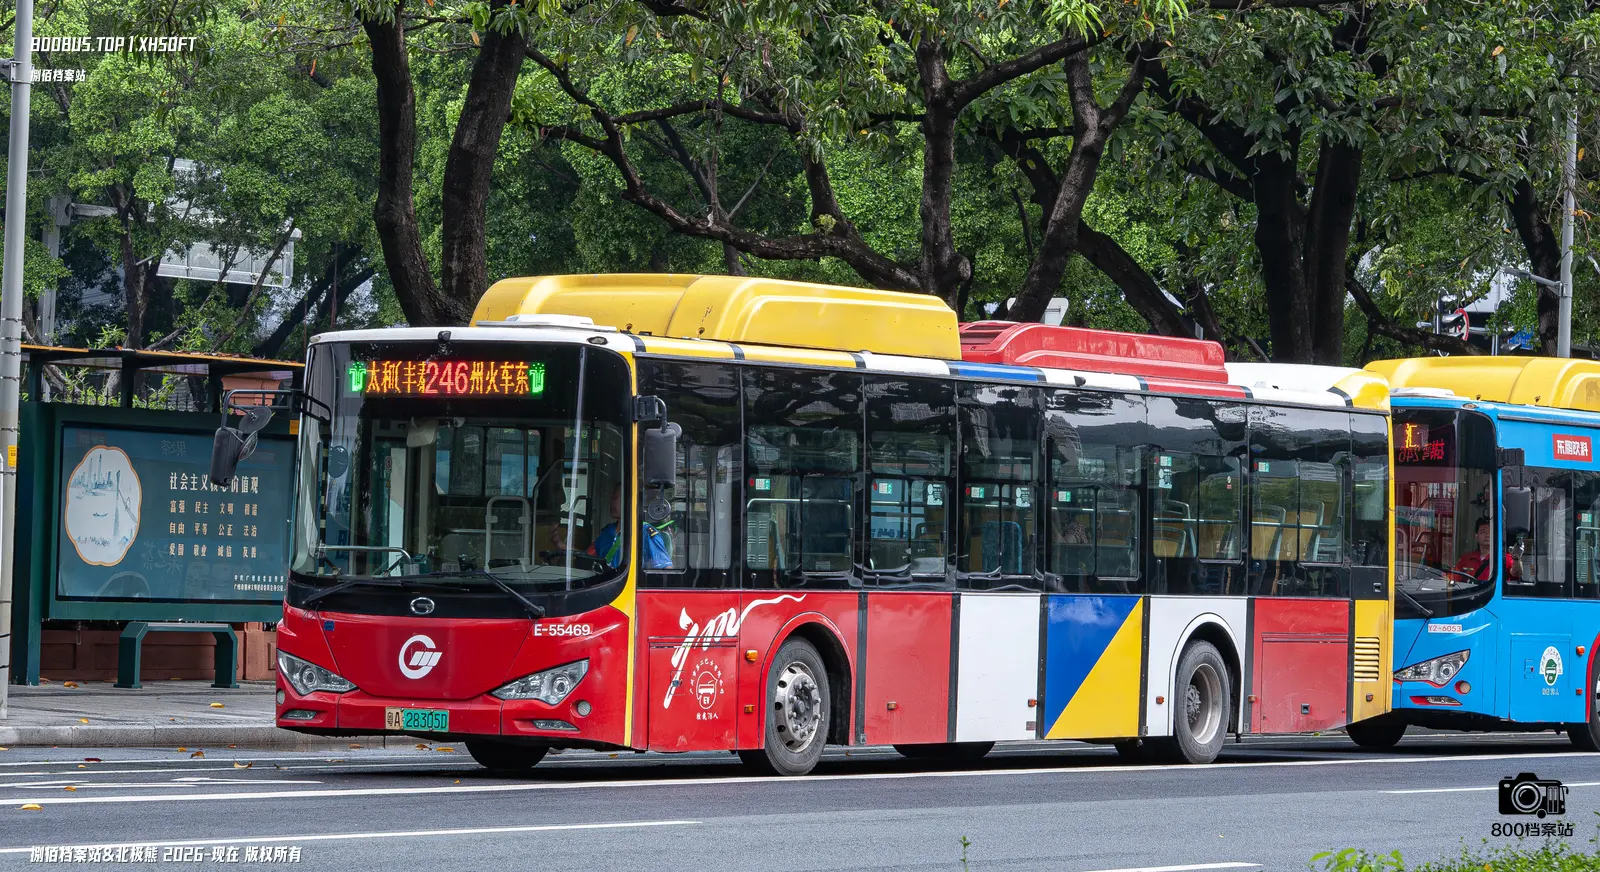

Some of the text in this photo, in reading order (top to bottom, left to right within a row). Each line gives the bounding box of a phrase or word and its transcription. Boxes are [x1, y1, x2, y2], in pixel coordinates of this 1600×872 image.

[424, 362, 468, 394] 246
[195, 501, 208, 514] 民主
[219, 502, 233, 515] 文明
[169, 522, 257, 537] 自由 平等 公正 法治
[534, 624, 591, 637] E-55469
